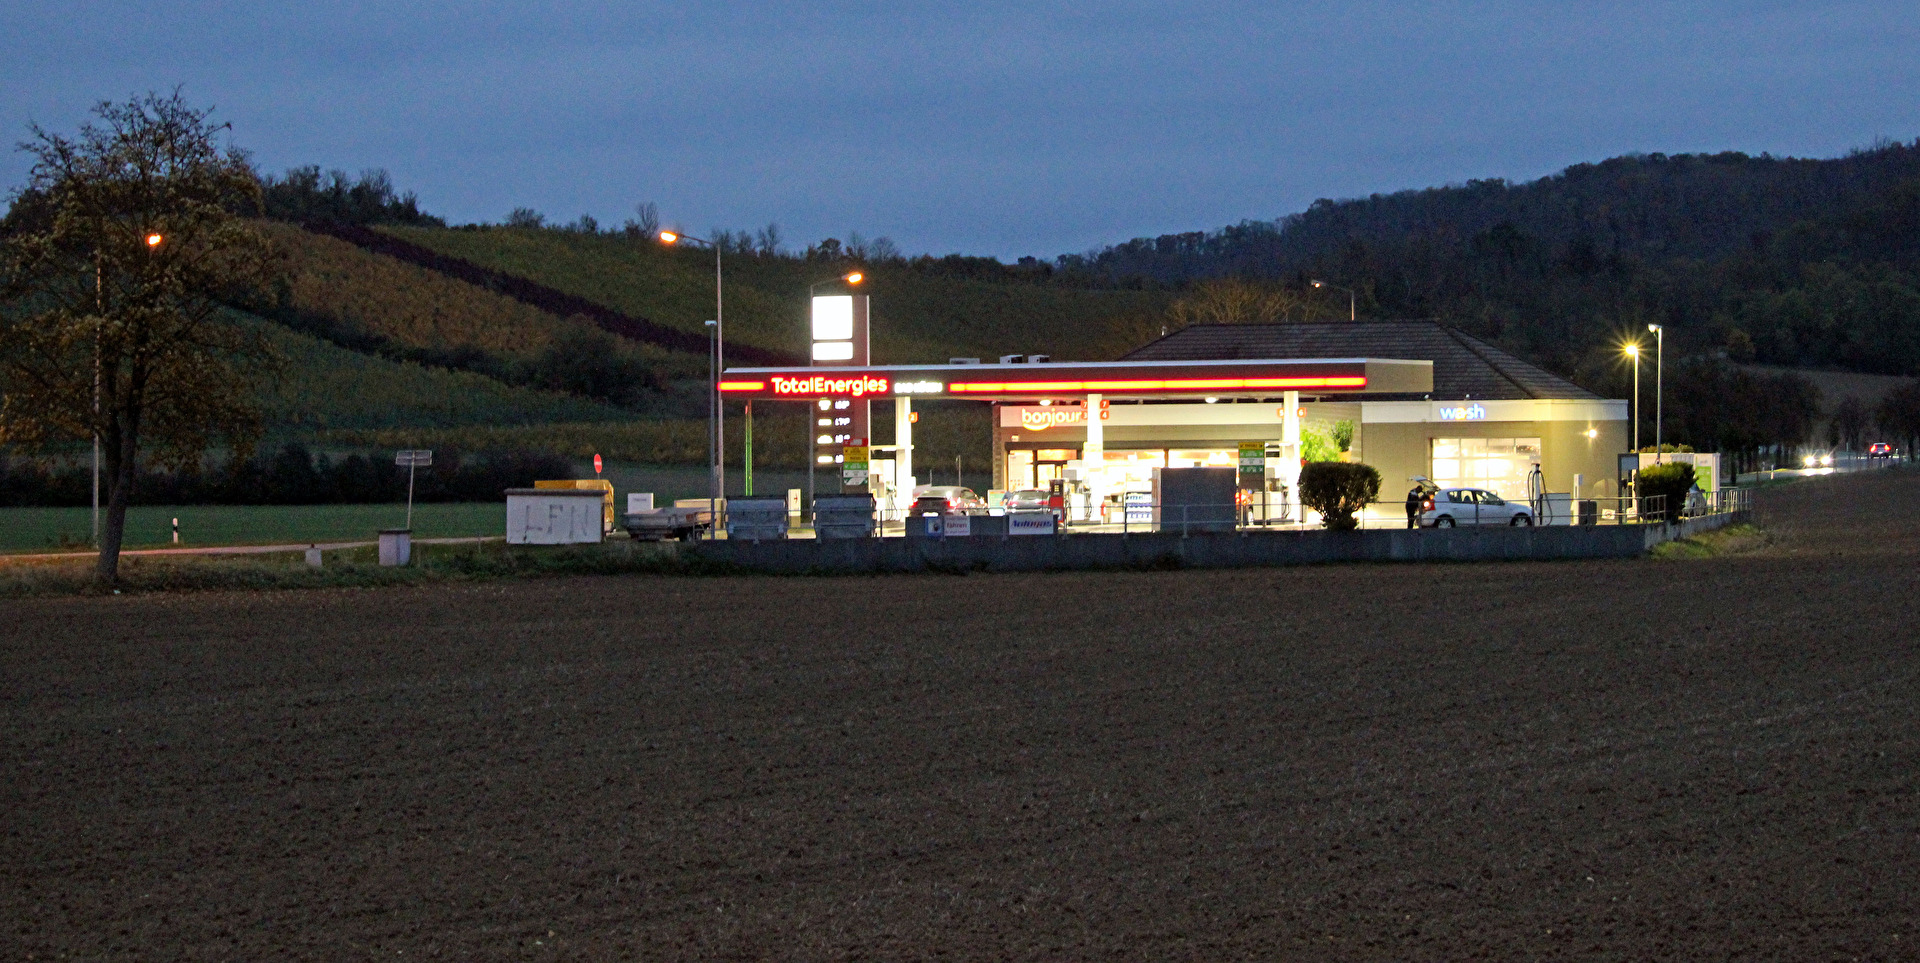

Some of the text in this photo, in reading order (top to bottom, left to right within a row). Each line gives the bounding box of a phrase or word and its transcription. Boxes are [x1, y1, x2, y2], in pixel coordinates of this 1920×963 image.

[771, 375, 888, 396] TotalEnergies
[1021, 408, 1081, 427] bonjour
[1440, 403, 1485, 420] wash
